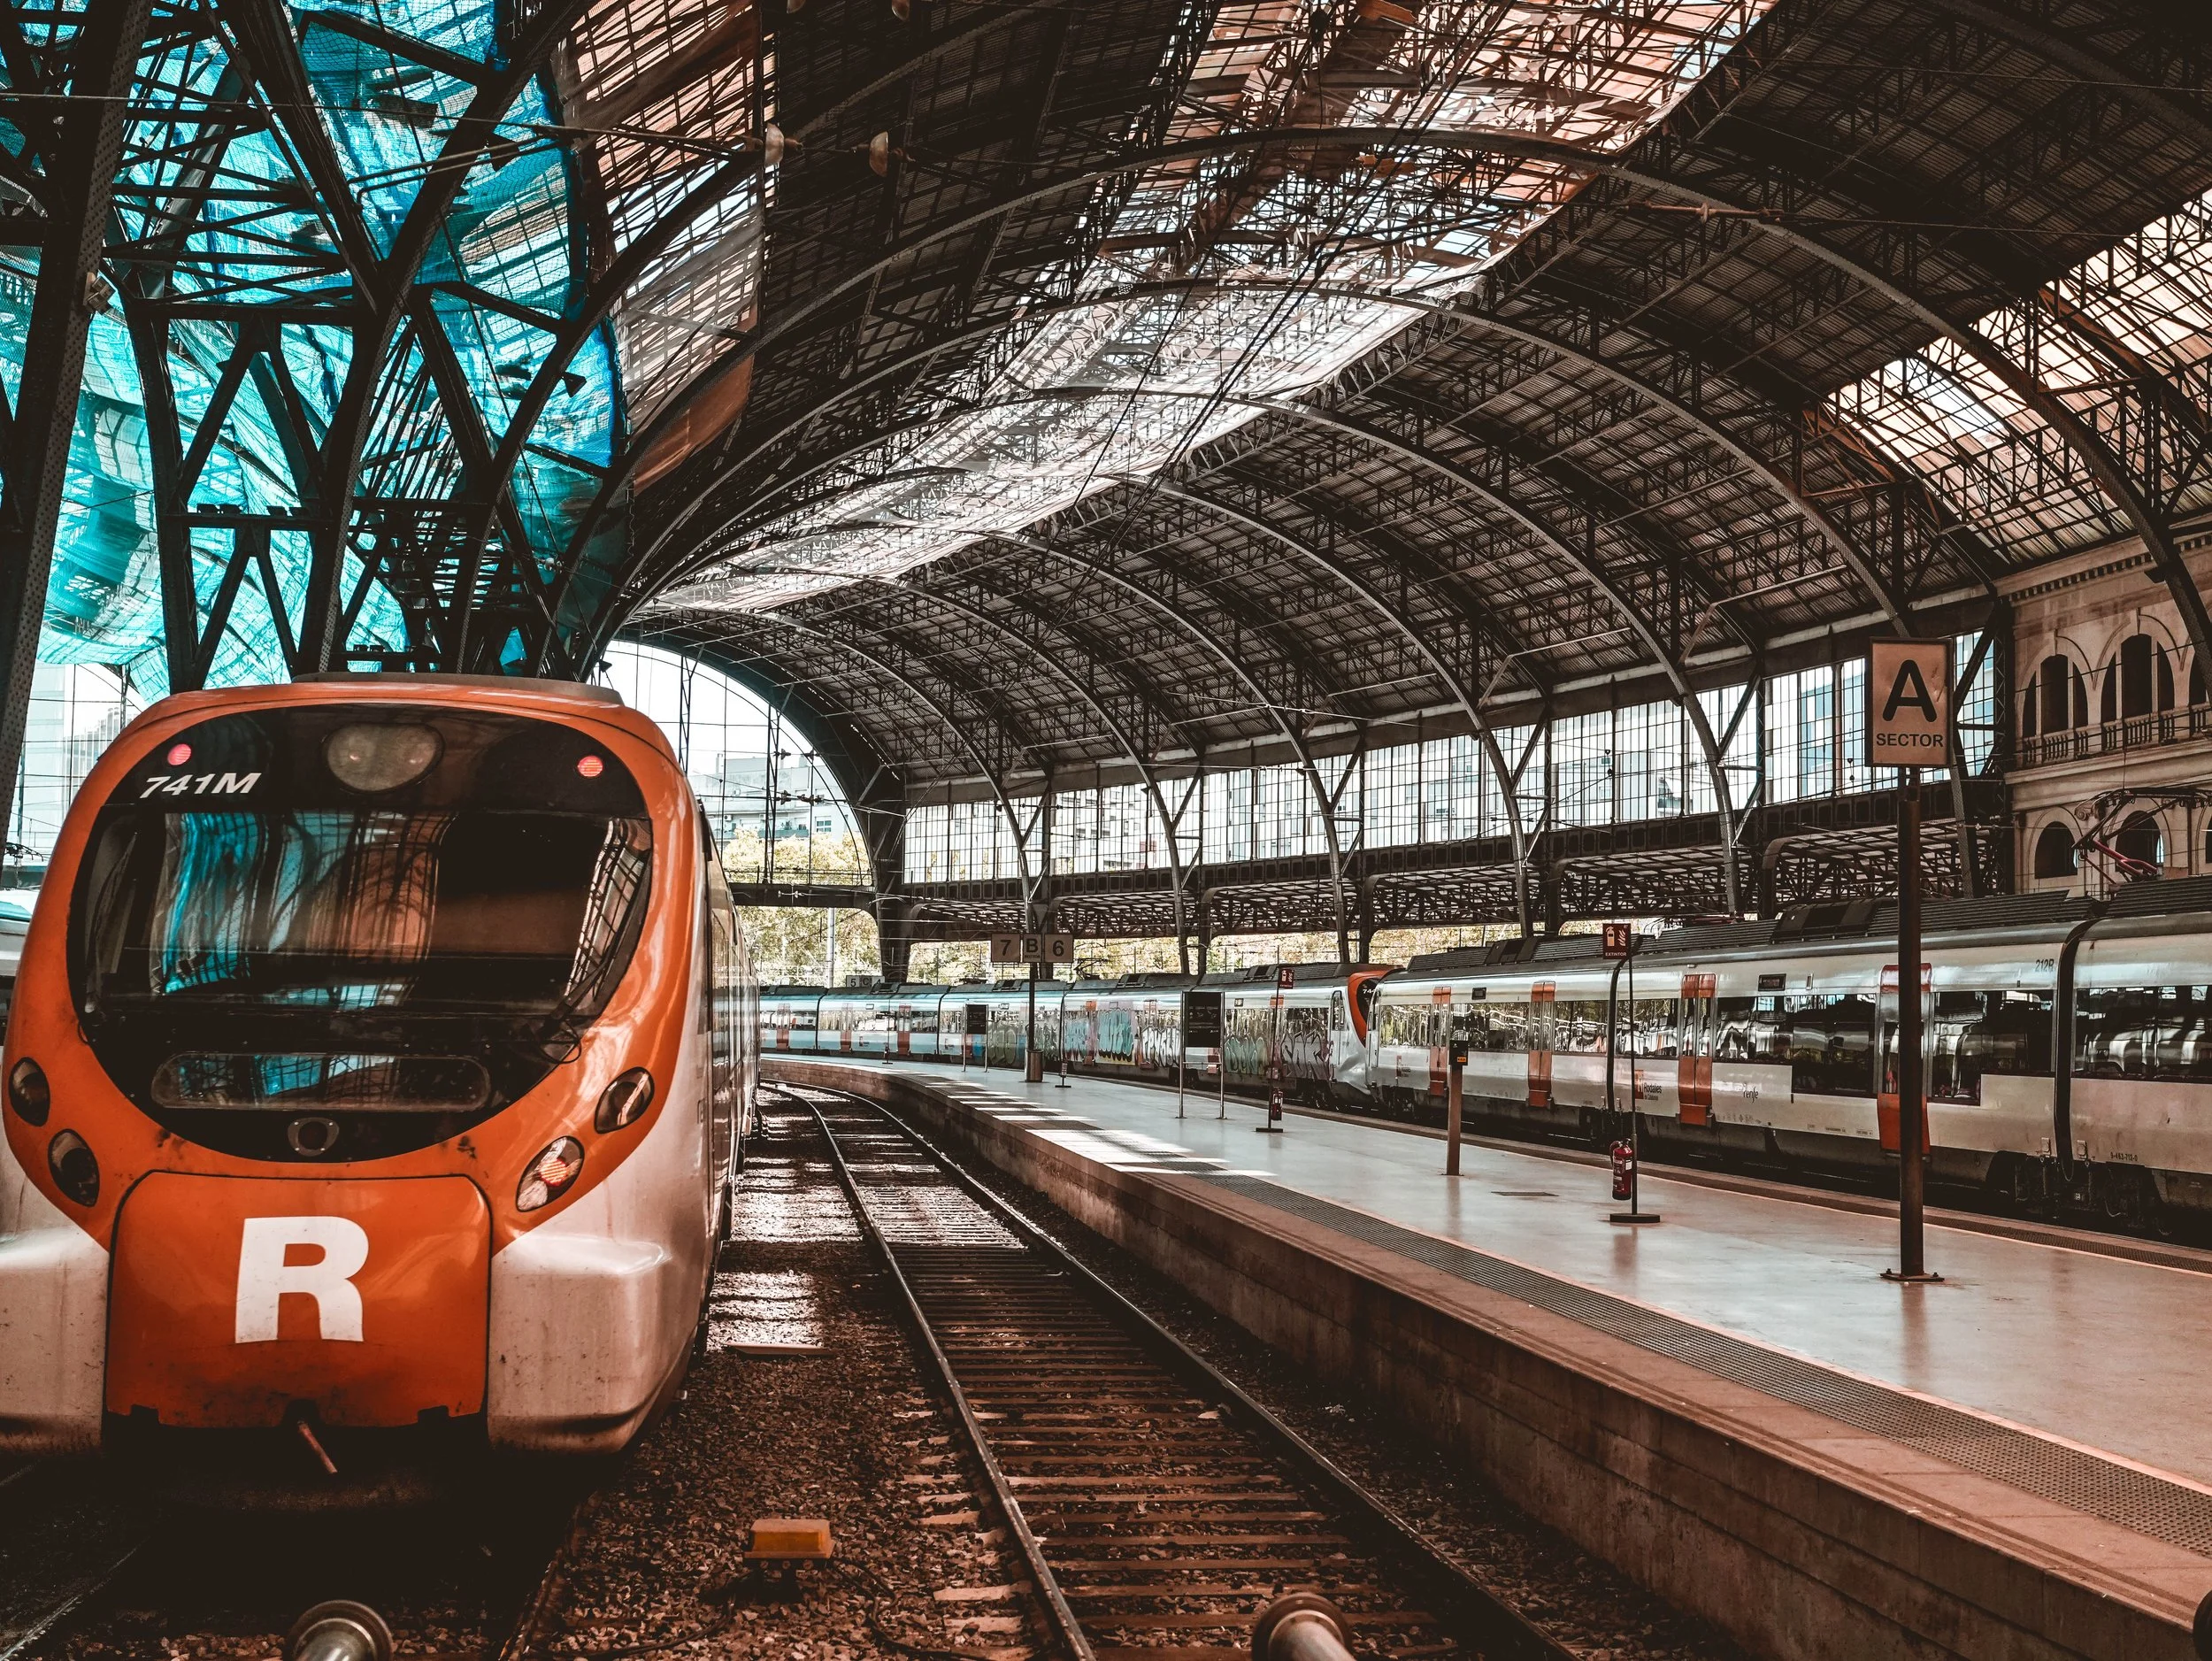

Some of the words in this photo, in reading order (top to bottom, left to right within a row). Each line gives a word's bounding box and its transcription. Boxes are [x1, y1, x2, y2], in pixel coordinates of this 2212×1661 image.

[1883, 659, 1938, 723] A
[1876, 733, 1945, 748] SECTOR
[139, 773, 263, 799] 741M
[1000, 939, 1011, 957] 7
[1026, 938, 1039, 953] B
[1052, 940, 1064, 957] 6
[850, 978, 856, 988] 5
[862, 977, 870, 986] C
[1644, 1082, 1663, 1094] Rodalies
[235, 1216, 369, 1344] R
